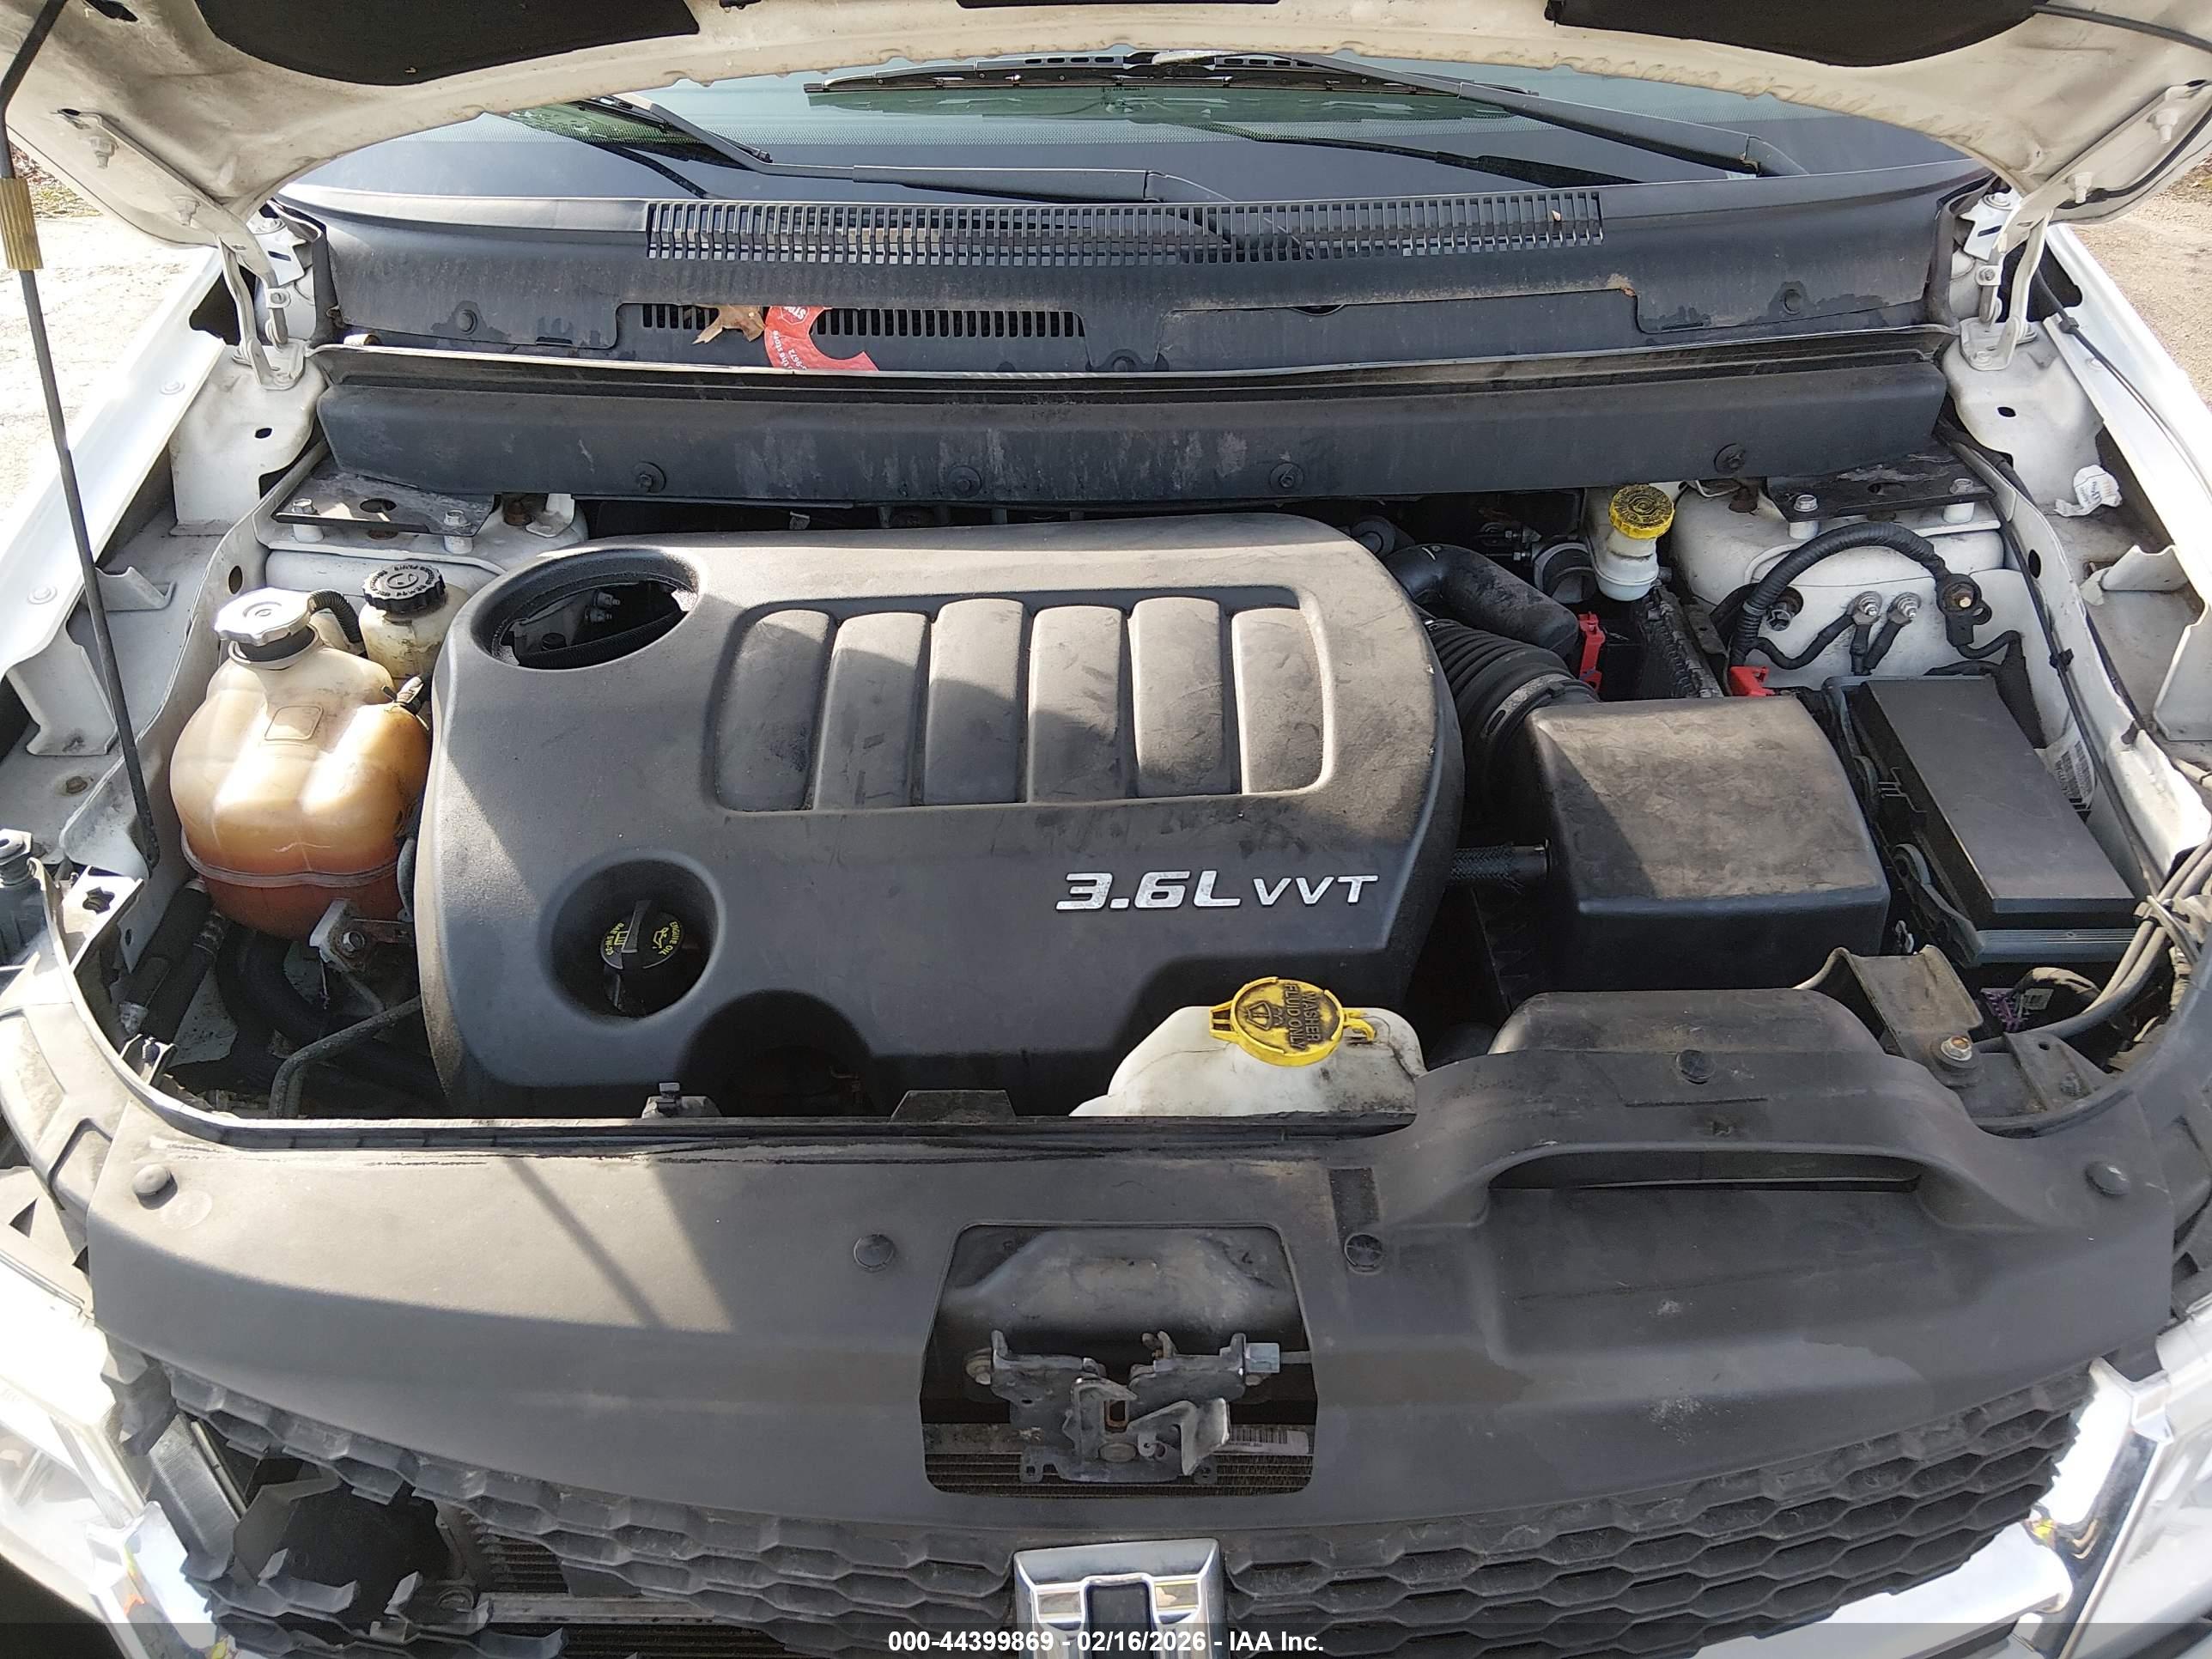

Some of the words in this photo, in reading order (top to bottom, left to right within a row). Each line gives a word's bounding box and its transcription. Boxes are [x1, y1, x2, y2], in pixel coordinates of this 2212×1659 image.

[1056, 870, 1242, 910] 3.6L
[1253, 875, 1379, 906] VVT
[669, 921, 680, 945] ENGINE
[658, 945, 673, 956] OIL
[1284, 984, 1300, 1018] FLUID
[1302, 992, 1321, 1042] WASHER
[1288, 1019, 1305, 1048] ONLY
